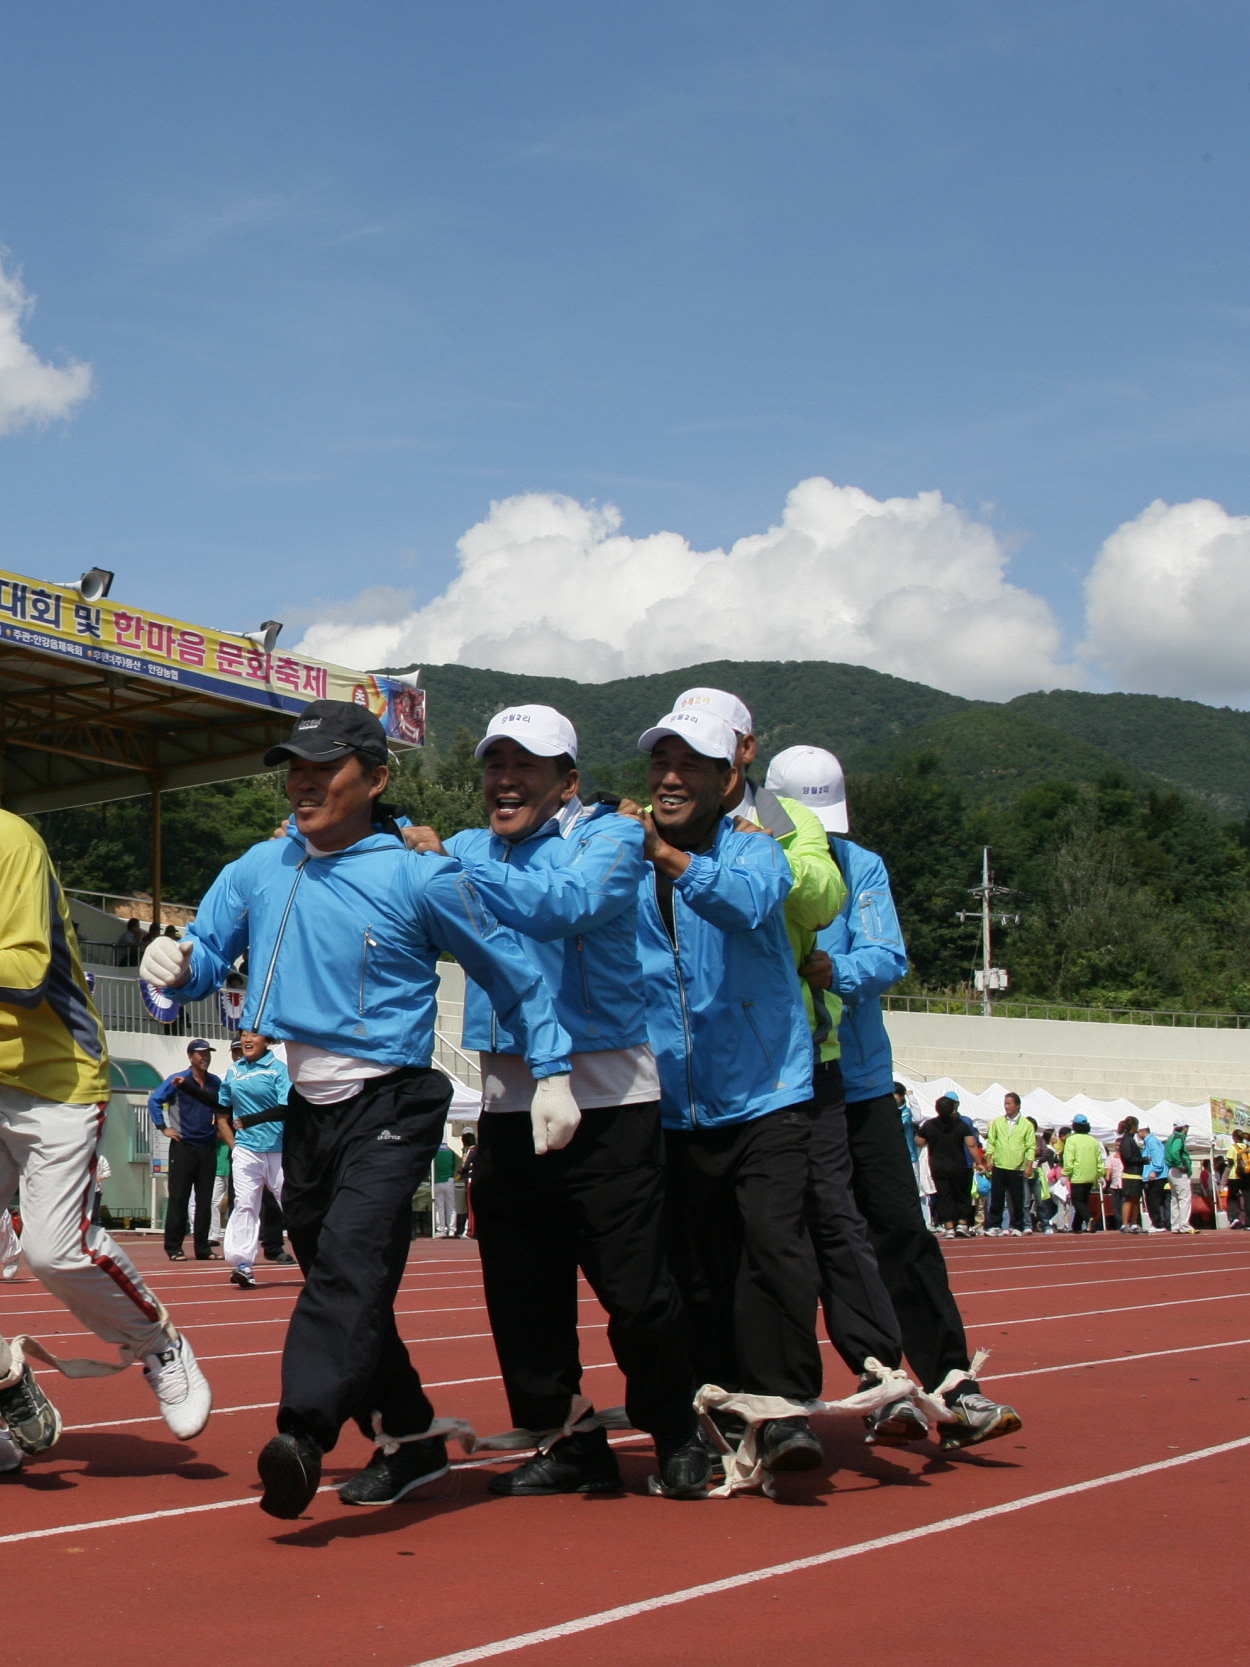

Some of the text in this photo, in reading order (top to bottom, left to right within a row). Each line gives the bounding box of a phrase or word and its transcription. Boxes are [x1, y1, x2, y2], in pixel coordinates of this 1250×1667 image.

[74, 604, 102, 639] 및
[113, 610, 207, 668] 한마음
[216, 640, 328, 699] 문화축제
